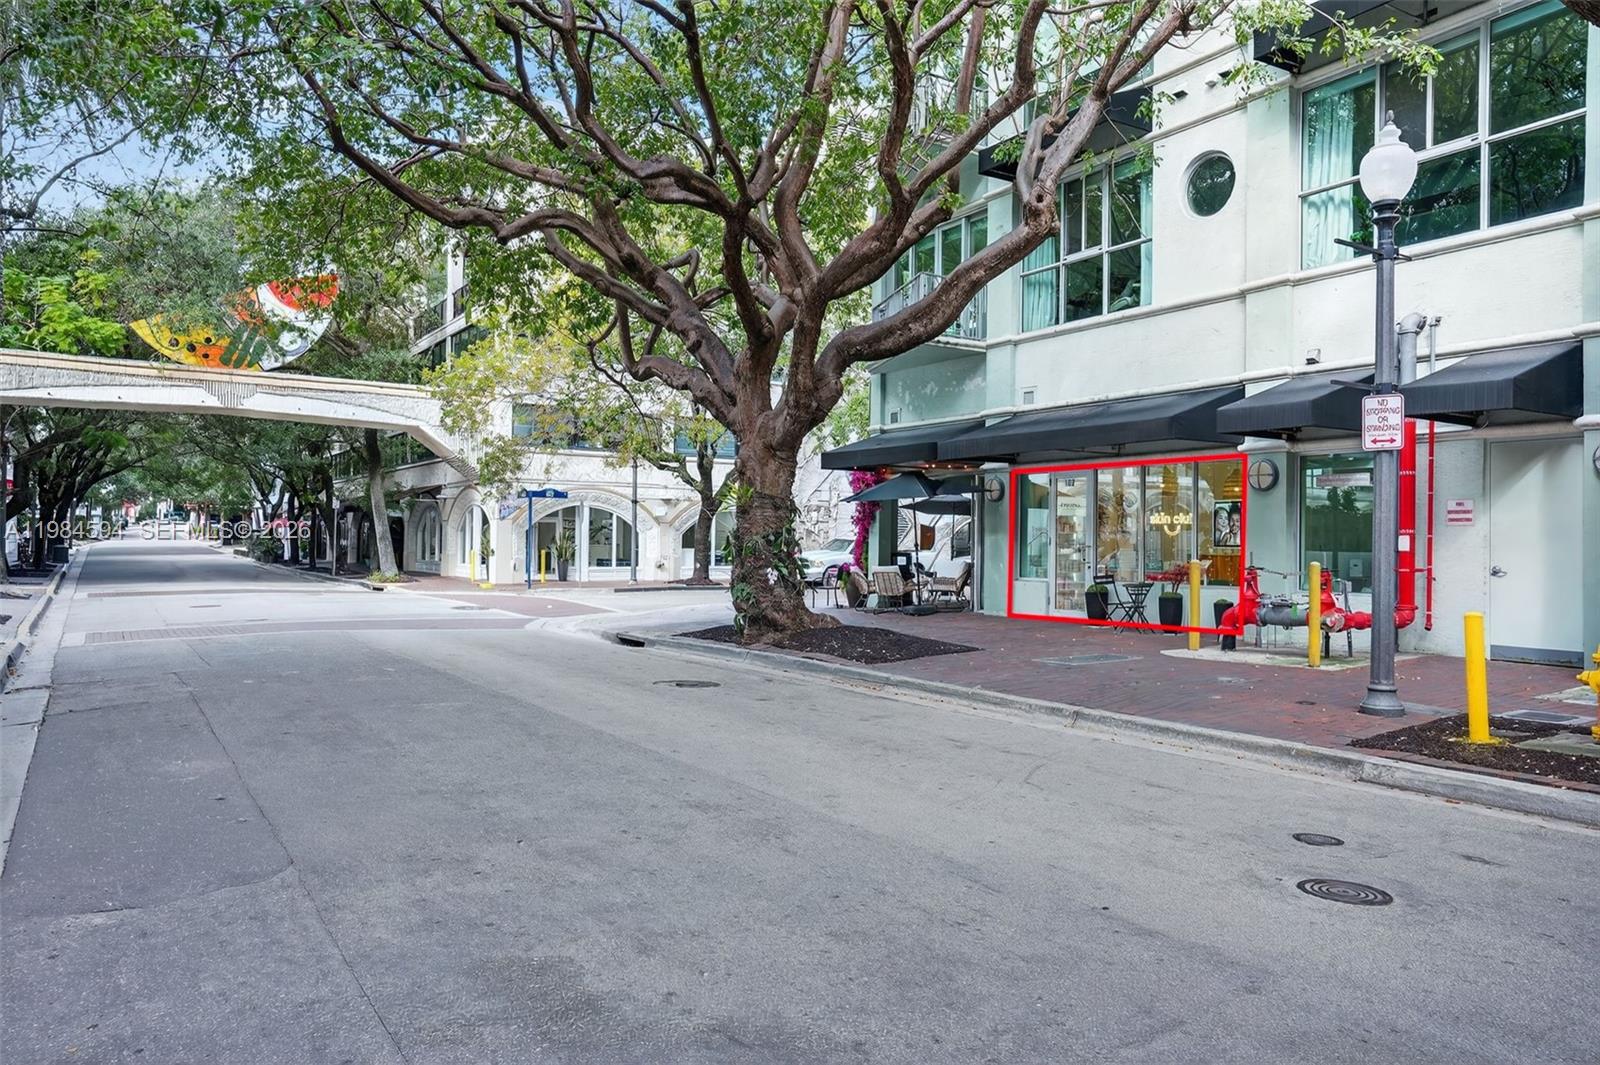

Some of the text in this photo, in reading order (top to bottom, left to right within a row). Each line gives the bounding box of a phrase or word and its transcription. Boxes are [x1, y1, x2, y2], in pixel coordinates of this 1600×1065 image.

[1377, 399, 1388, 407] NO
[1377, 416, 1389, 424] OR
[1366, 424, 1400, 433] STANDING
[1150, 512, 1171, 525] skin
